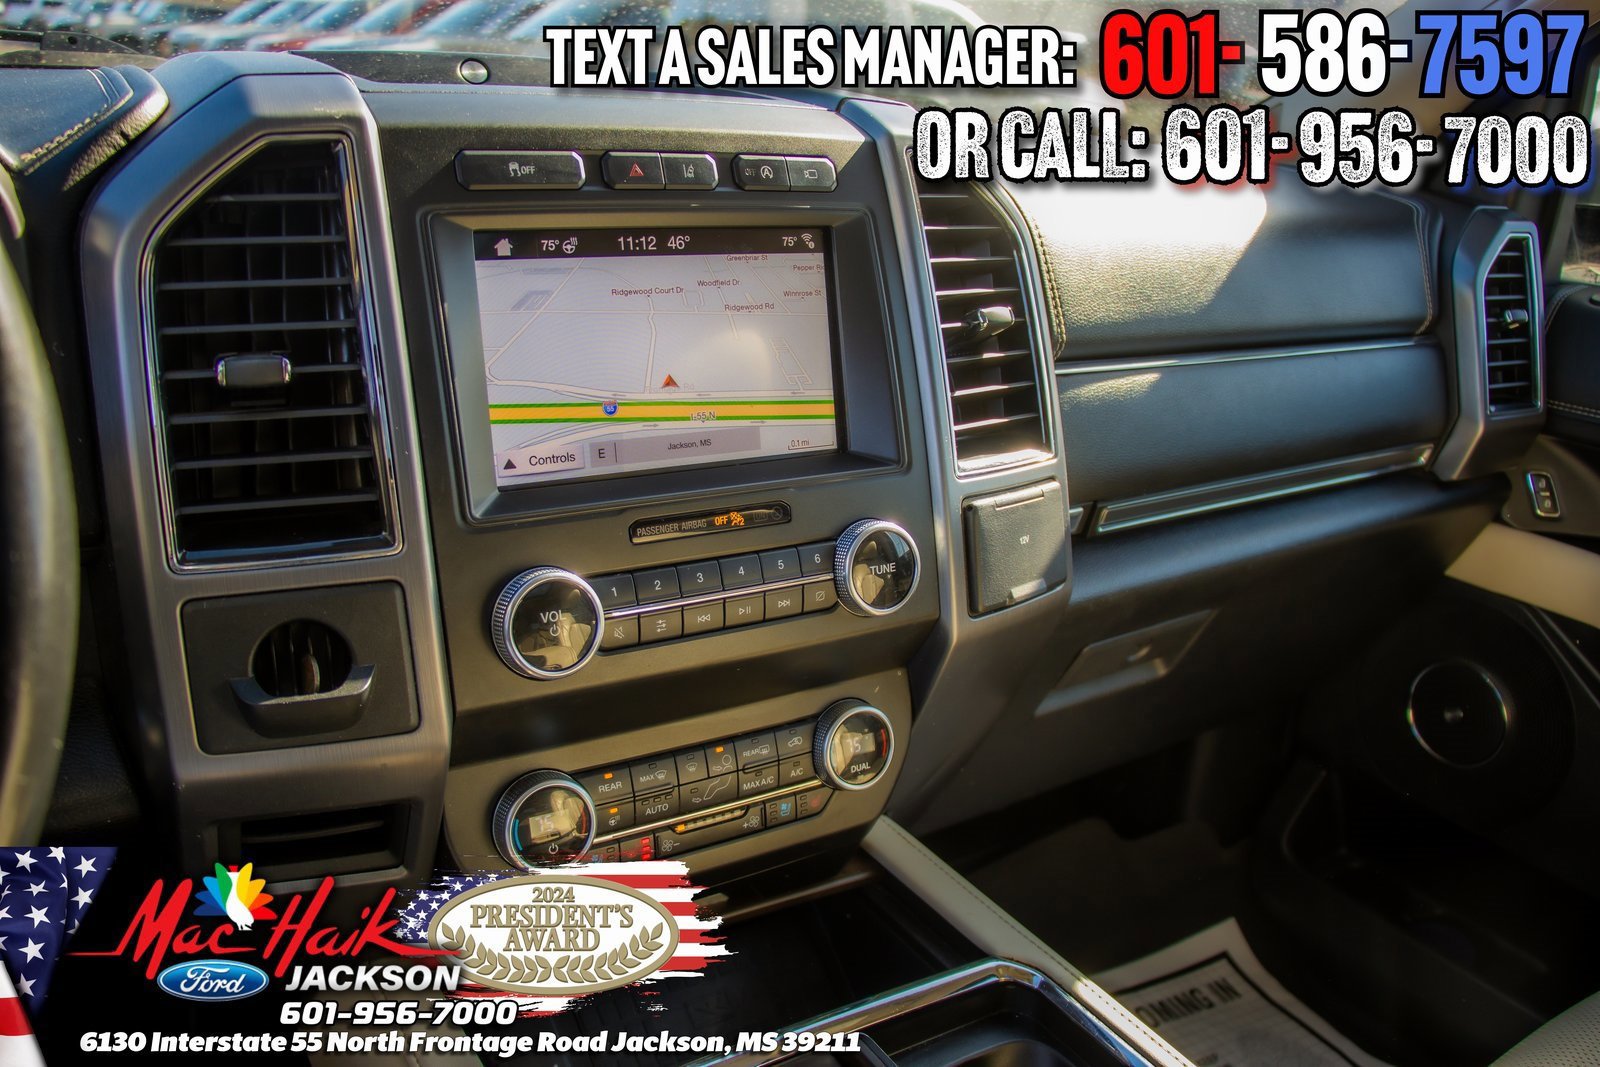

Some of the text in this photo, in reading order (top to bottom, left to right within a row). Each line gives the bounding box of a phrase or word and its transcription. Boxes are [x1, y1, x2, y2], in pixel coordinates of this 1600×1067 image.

[520, 166, 535, 176] OFF
[618, 236, 656, 250] 11:12
[668, 235, 690, 250] 46°
[611, 288, 653, 297] Ridgewood
[724, 304, 761, 313] Ridgewood
[709, 411, 716, 420] N
[598, 438, 712, 459] E Jackson, MS
[801, 439, 810, 447] mi
[529, 452, 576, 467] Controls
[637, 523, 679, 537] PASSENGER
[681, 519, 707, 531] AIRBAG
[714, 515, 728, 526] OFF
[814, 552, 822, 564] 6
[777, 559, 785, 570] 5
[870, 562, 896, 575] TUNE
[737, 565, 745, 577] 4
[696, 572, 704, 584] 3
[654, 579, 662, 591] 2
[611, 586, 618, 598] 1
[540, 611, 567, 624] VOL
[742, 748, 760, 758] REAR
[790, 767, 804, 778] A/C
[850, 762, 871, 774] DUAL
[639, 773, 656, 783] MAX
[743, 775, 775, 791] MAX A/C
[598, 781, 623, 794] REAR
[645, 803, 669, 816] AUTO
[1135, 988, 1215, 1029] OMING
